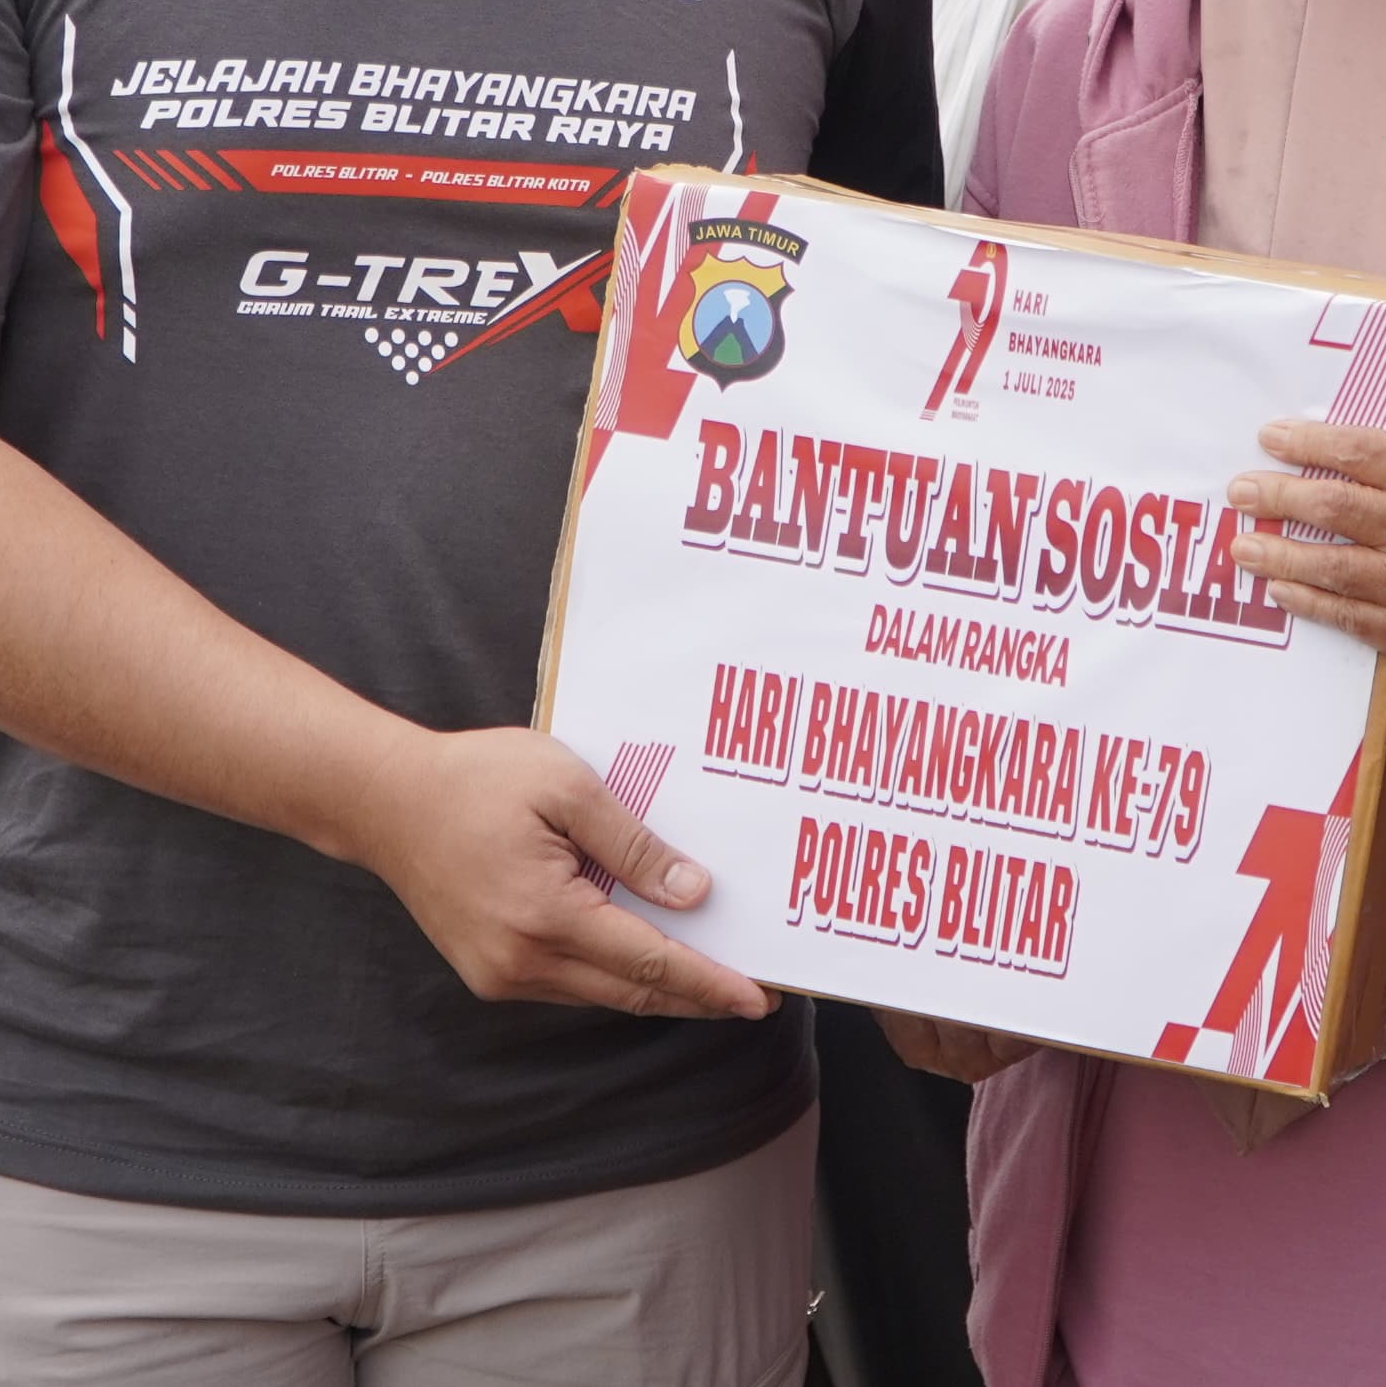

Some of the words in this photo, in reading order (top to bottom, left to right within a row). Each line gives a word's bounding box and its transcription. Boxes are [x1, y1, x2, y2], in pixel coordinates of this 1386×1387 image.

[110, 59, 342, 96] JELAJAH
[348, 63, 697, 122] BHAYANGKARA
[140, 99, 352, 129] POLRES
[360, 103, 536, 141] BLITAR
[545, 115, 674, 151] RAYA
[271, 164, 336, 179] POLRES
[338, 167, 399, 181] BLITAR
[421, 170, 485, 187] POLRES
[486, 174, 545, 189] BLITAR
[547, 178, 590, 193] KOTA
[696, 224, 742, 241] JAWA
[748, 227, 799, 256] TIMUR
[237, 300, 315, 316] GARUM
[321, 304, 378, 319] TRAIL
[384, 308, 488, 326] EXTREME
[239, 249, 611, 333] G-TREX
[1013, 289, 1049, 316] HARI
[1008, 332, 1102, 366] BHAYANGKARA
[1003, 370, 1010, 390] 1
[1014, 371, 1043, 396] JULI
[1045, 377, 1076, 401] 2025
[683, 418, 1040, 598] BANTUAN
[865, 604, 961, 667] DALAM
[960, 621, 1069, 687] RANGKA
[703, 663, 800, 779] HARI
[801, 682, 1082, 833] BHAYANGKARA
[1087, 734, 1208, 854] KE-79
[788, 816, 933, 942] POLRES
[936, 844, 1077, 971] BLITAR
